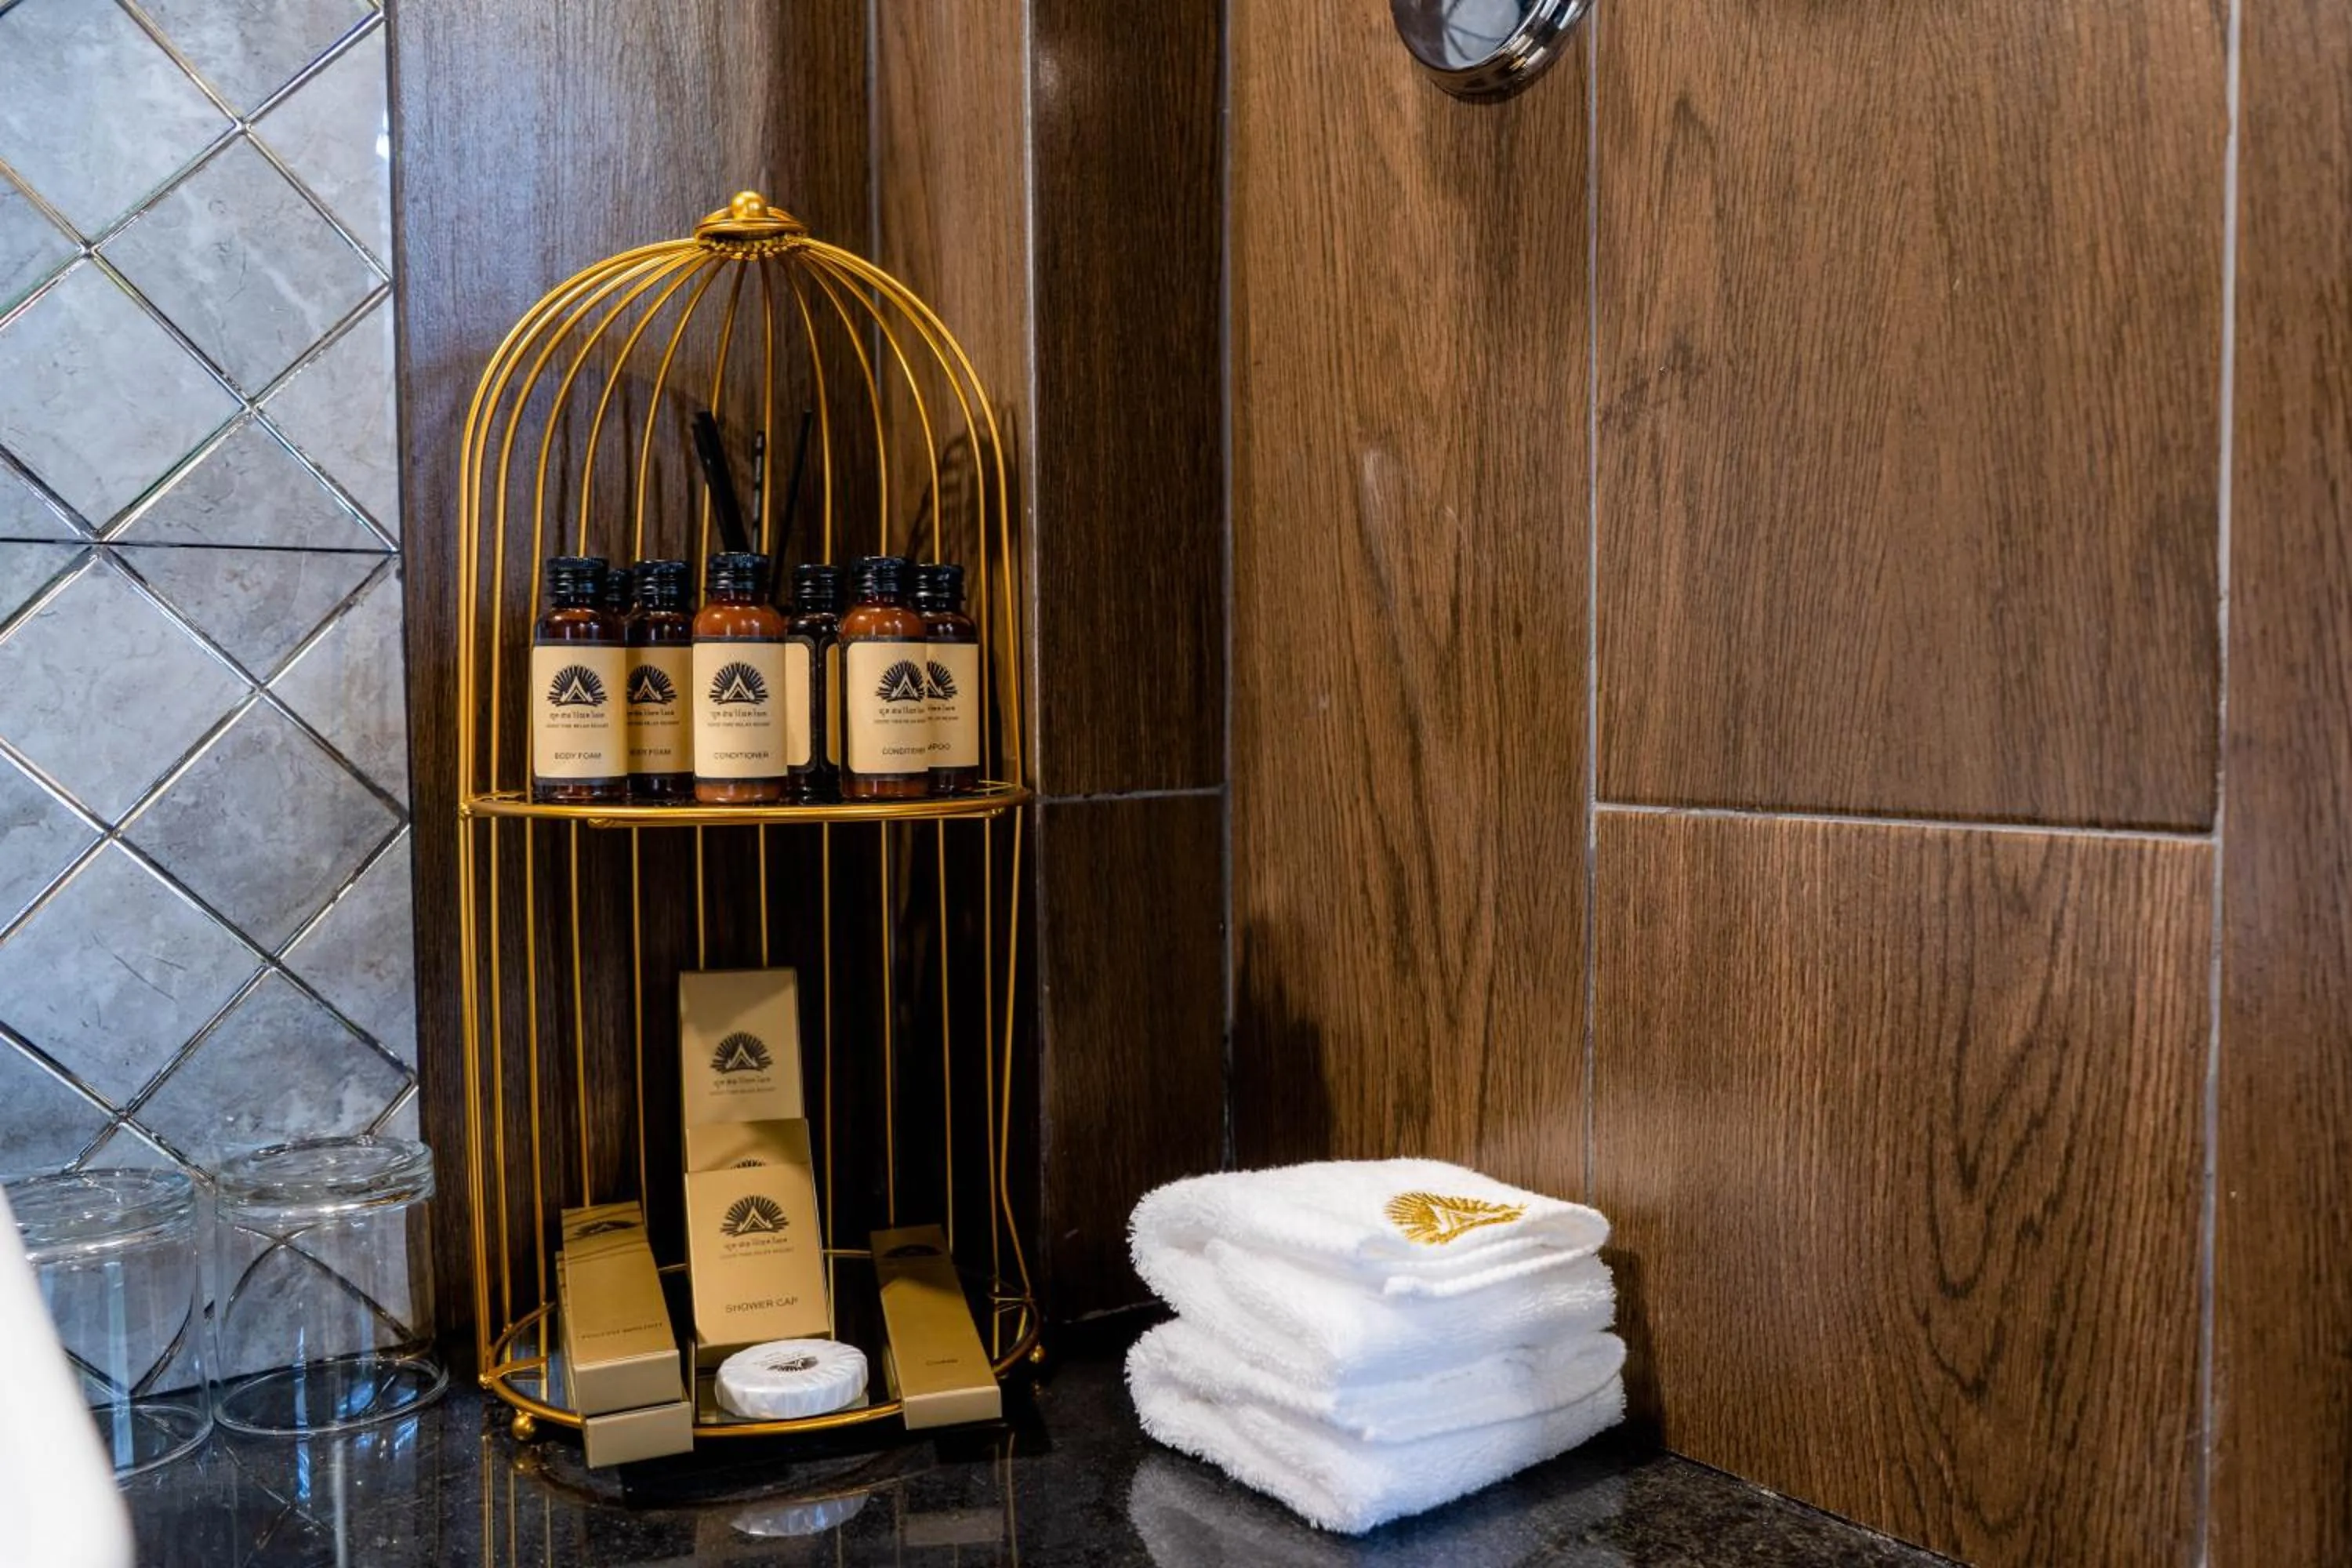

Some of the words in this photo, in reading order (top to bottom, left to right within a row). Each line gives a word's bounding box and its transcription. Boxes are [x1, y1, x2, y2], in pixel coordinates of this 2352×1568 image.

[713, 751, 769, 760] CONDITIONER
[725, 1298, 773, 1313] SHOWER
[775, 1295, 799, 1307] CAP
